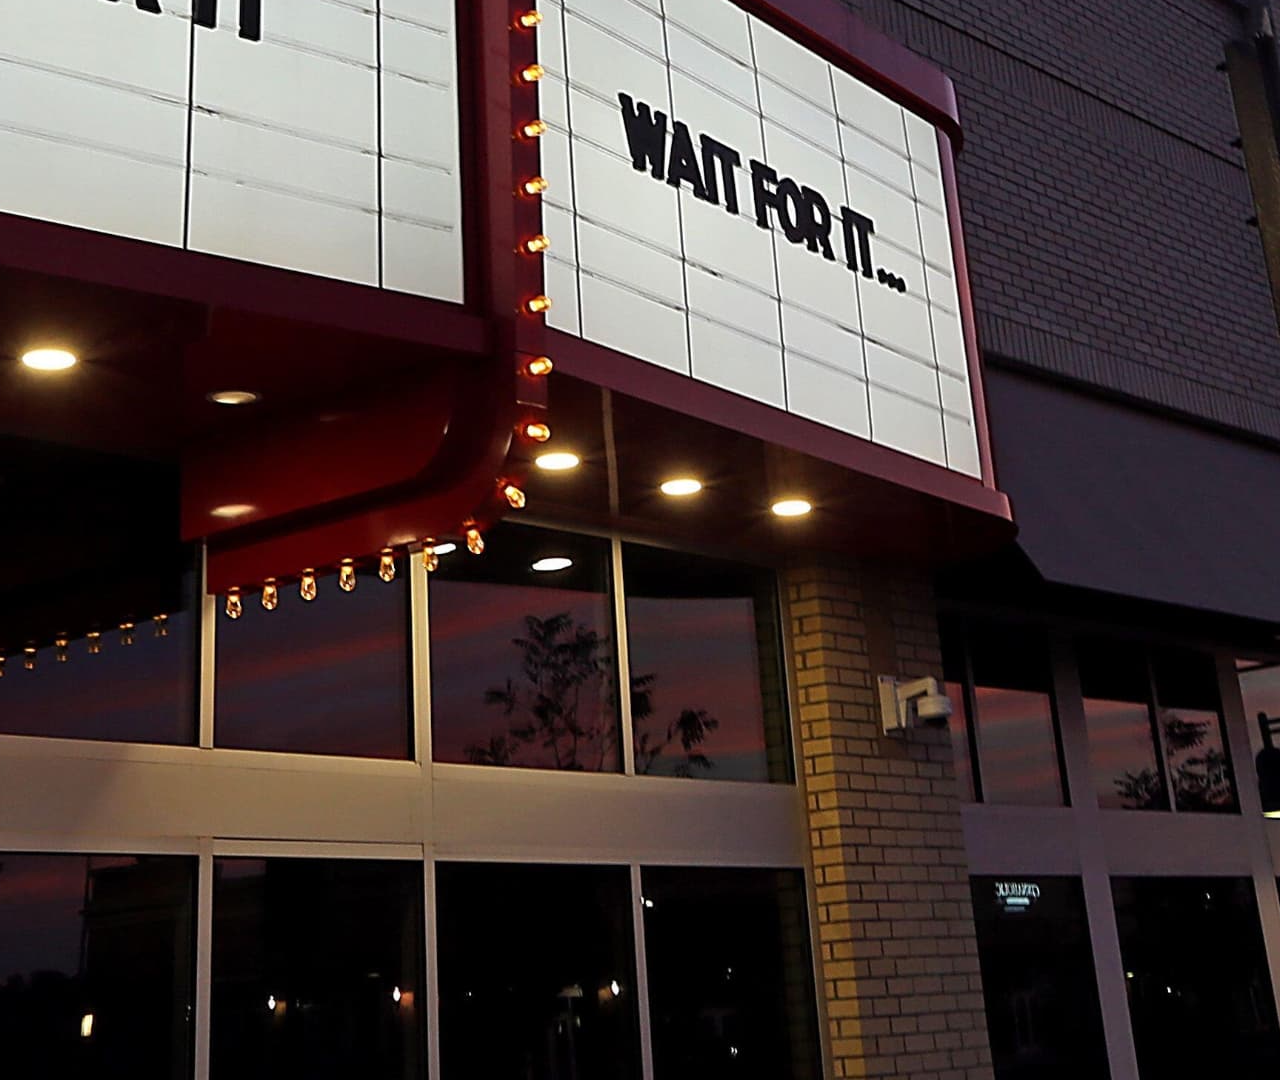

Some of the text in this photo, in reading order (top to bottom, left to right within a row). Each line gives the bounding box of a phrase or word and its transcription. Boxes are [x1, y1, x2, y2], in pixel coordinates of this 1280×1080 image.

[618, 92, 906, 293] WAIT FOR IT...
